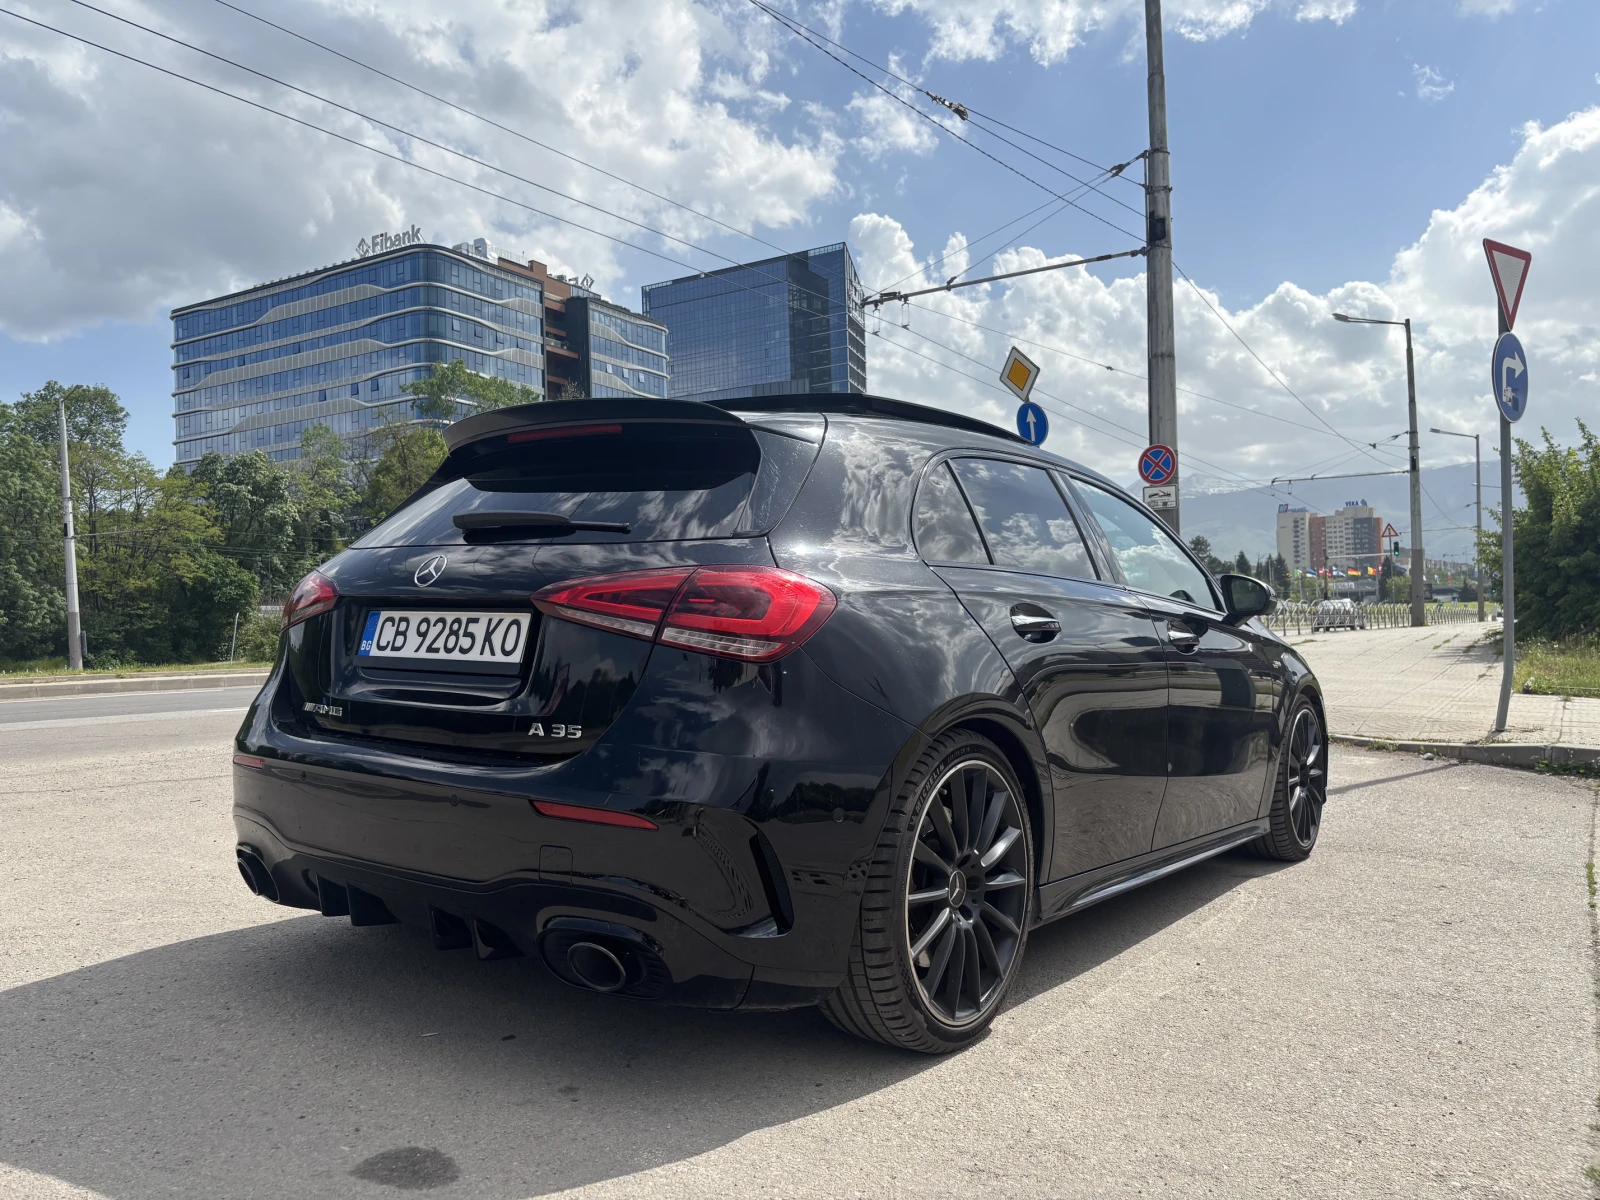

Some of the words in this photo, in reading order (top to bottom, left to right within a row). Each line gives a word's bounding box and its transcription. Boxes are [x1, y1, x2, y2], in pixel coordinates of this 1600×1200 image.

[372, 224, 421, 255] Fibank
[360, 640, 373, 651] BG
[376, 616, 411, 652] CB
[414, 617, 480, 656] 9285
[480, 617, 522, 657] KO
[528, 722, 545, 737] A
[550, 723, 582, 739] 35
[914, 761, 945, 814] MICHELIN
